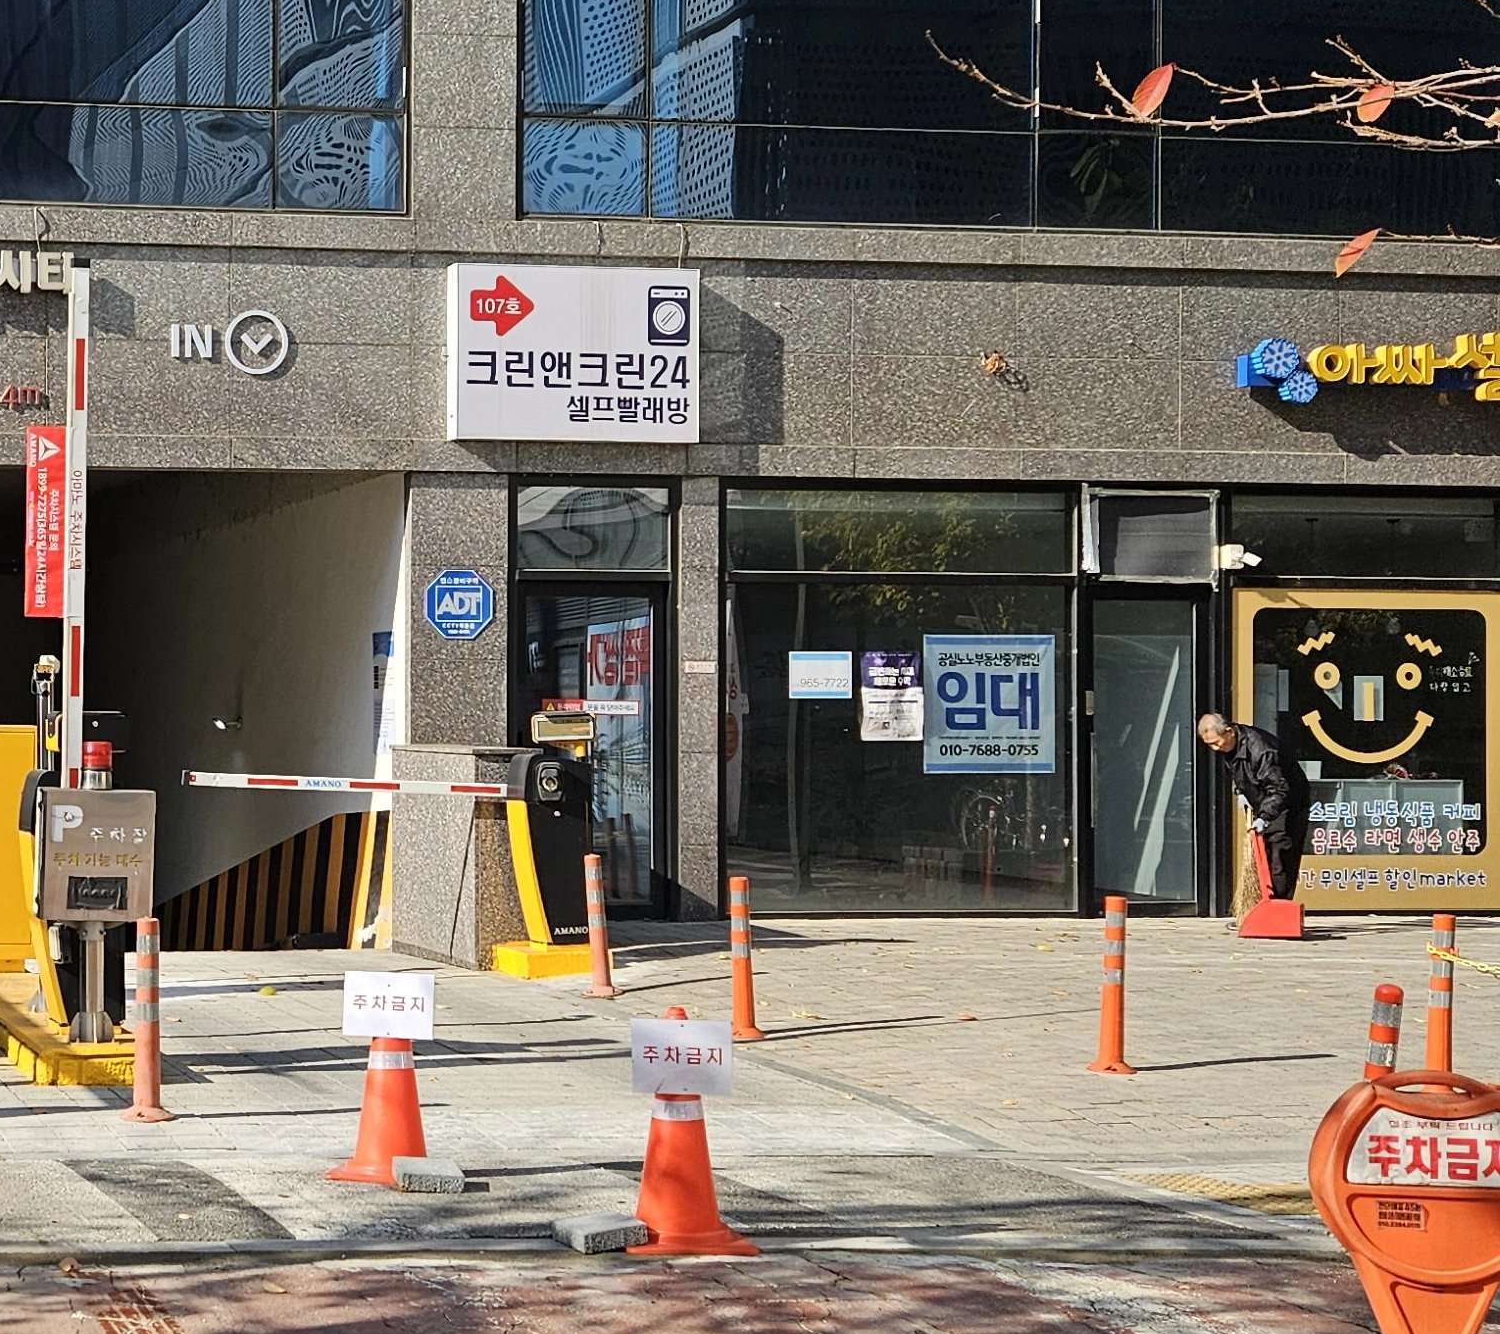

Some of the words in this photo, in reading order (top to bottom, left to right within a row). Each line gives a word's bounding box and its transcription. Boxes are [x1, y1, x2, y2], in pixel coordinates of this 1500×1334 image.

[475, 296, 522, 316] 107호
[171, 323, 212, 358] IN
[466, 350, 690, 389] 크린앤크린24
[566, 395, 690, 424] 셀프빨래방
[71, 470, 83, 505] 아마노
[69, 510, 83, 570] 주차시스템
[437, 592, 481, 615] ADT
[800, 678, 849, 688] 965-7722
[936, 671, 1040, 731] 임대
[939, 744, 1040, 757] 010-7688-0755
[51, 805, 84, 843] P
[1308, 800, 1358, 828] 스크림
[1363, 799, 1435, 828] 냉동식품
[1442, 802, 1482, 821] 커피
[1312, 827, 1357, 855] 음료수
[1364, 829, 1400, 854] 라면
[1408, 827, 1442, 854] 생수
[1446, 828, 1481, 854] 안주
[1320, 868, 1380, 891] 무인셀프
[553, 926, 589, 936] AMANO
[352, 994, 426, 1013] 주차금지
[642, 1045, 723, 1065] 주차금지
[1445, 1121, 1494, 1132] 드립니다
